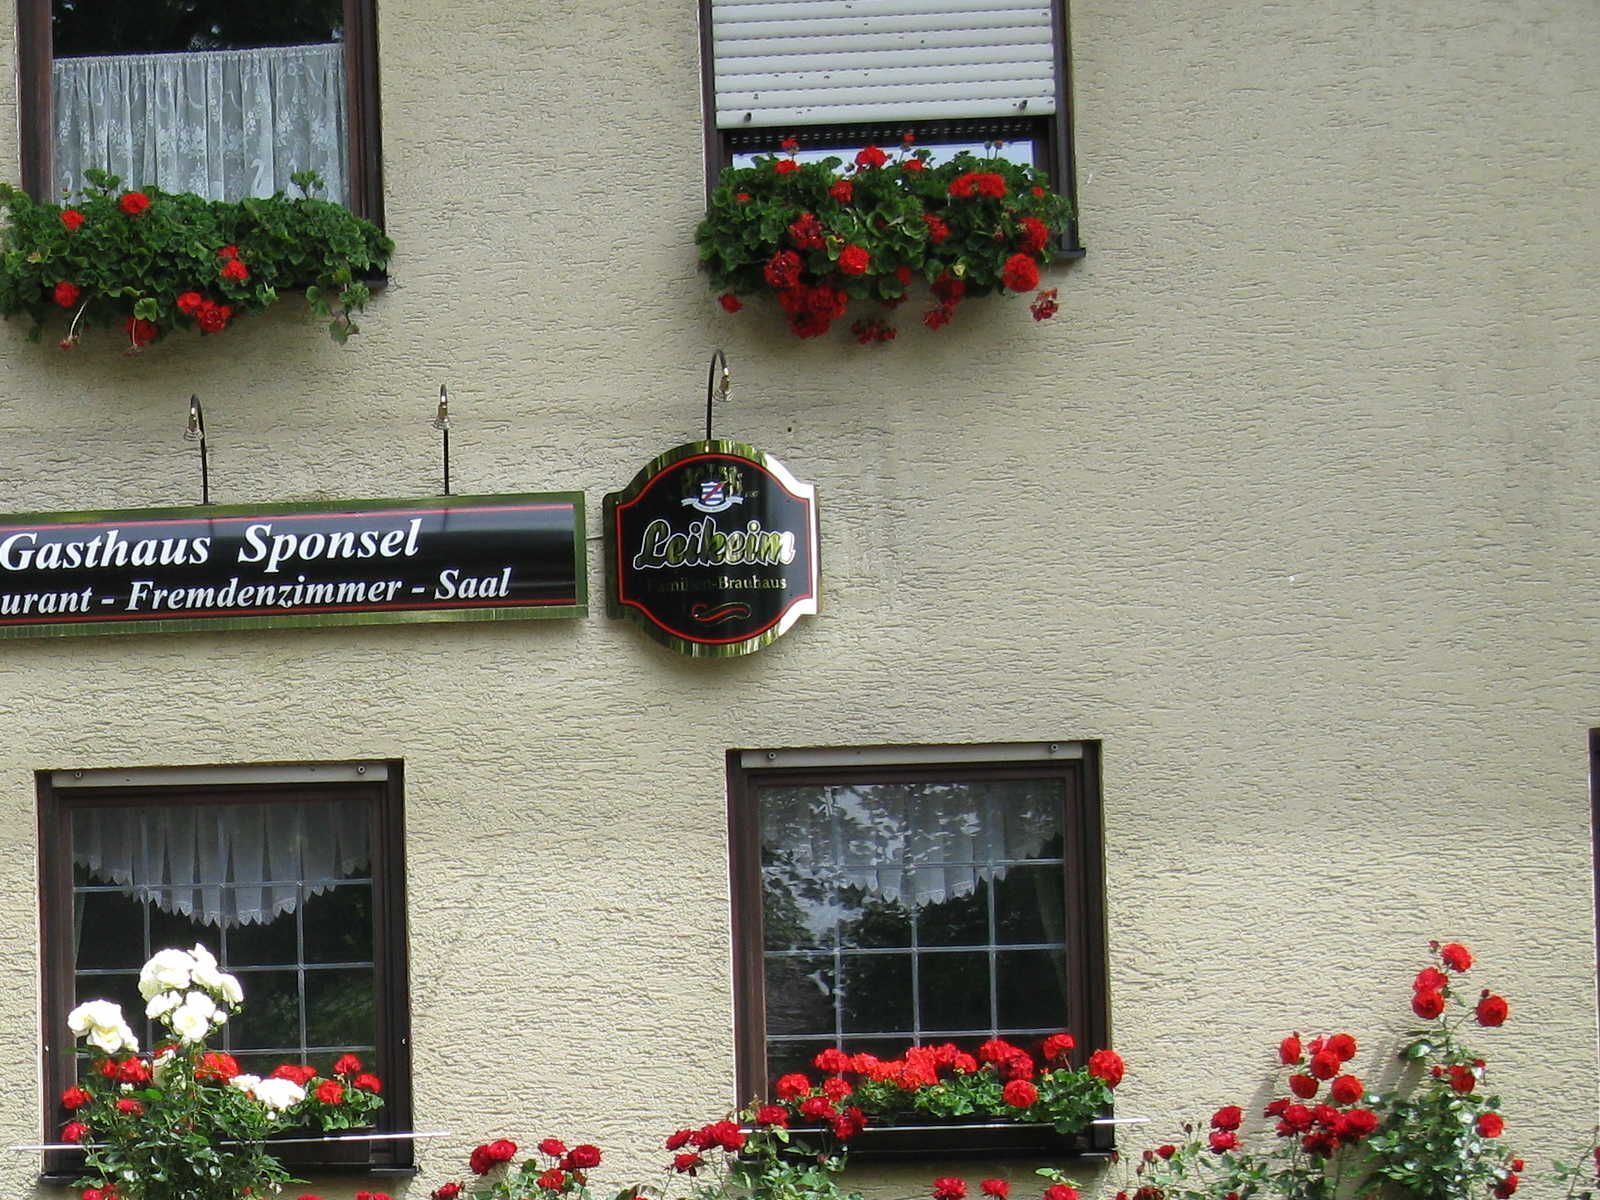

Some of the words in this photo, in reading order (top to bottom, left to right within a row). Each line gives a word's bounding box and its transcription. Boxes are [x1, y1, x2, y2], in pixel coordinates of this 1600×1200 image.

[0, 529, 211, 571] Gasthaus
[238, 518, 423, 573] Sponsel
[633, 515, 795, 570] Leikeim
[125, 575, 402, 611] Fremdenzimmer
[434, 568, 512, 600] Saal
[648, 575, 788, 592] Familn-Brauhaus
